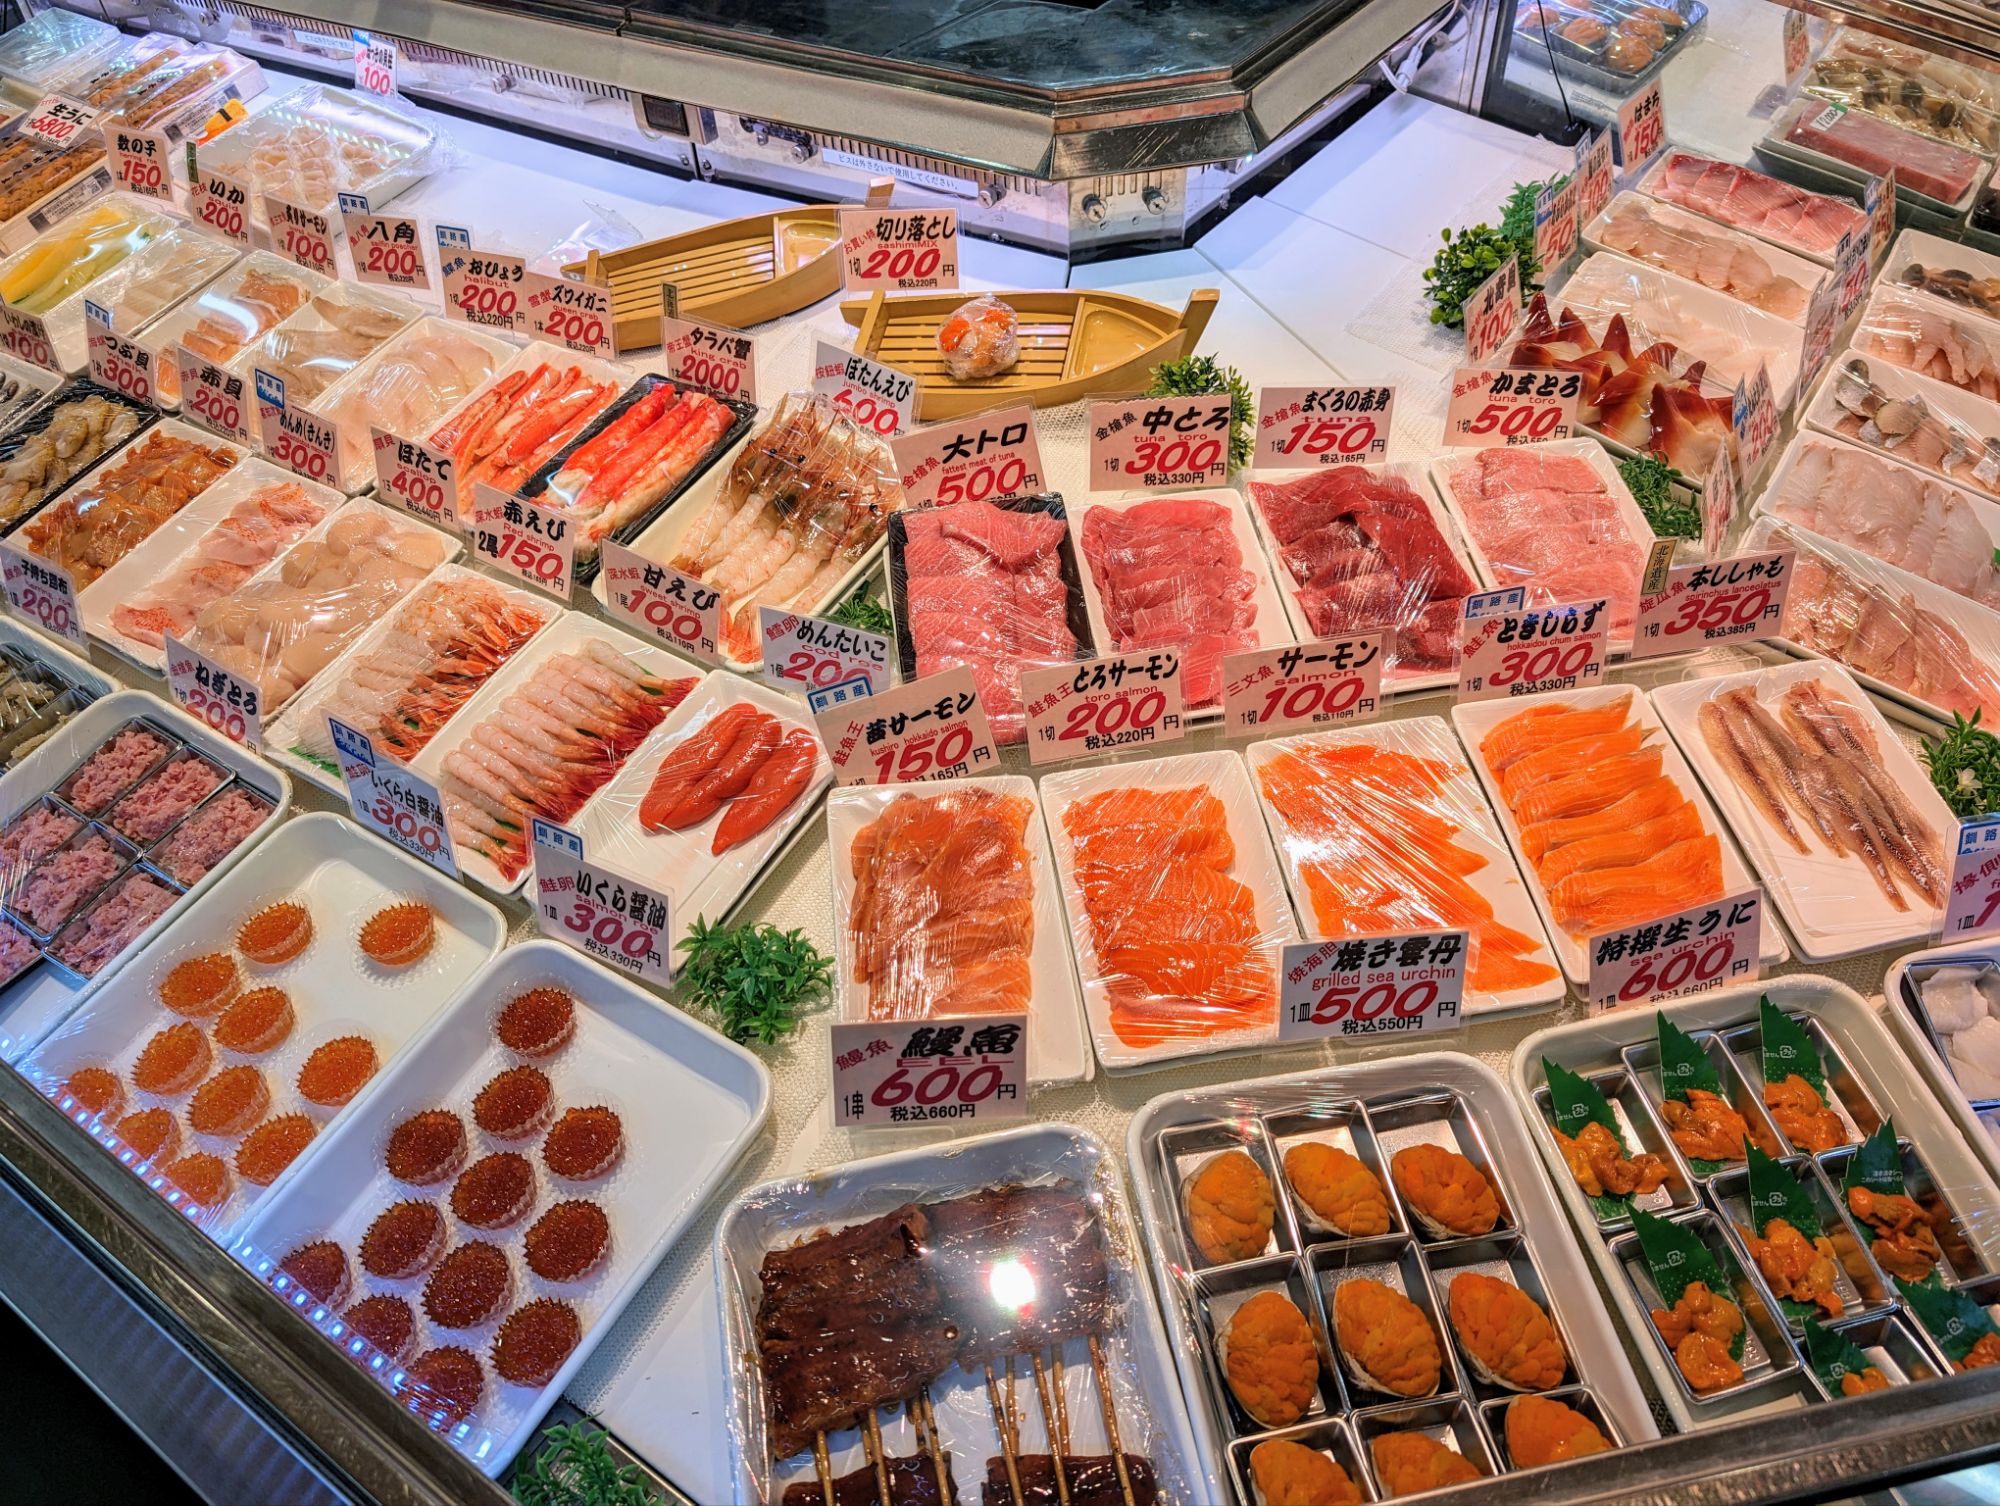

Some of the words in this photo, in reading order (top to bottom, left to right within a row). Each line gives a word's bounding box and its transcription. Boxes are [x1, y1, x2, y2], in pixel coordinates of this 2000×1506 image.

[364, 66, 390, 95] 100
[31, 115, 76, 139] 6800
[48, 103, 93, 126] 生うに
[117, 134, 156, 157] 数の子
[123, 160, 162, 187] 150
[208, 196, 239, 213] squid
[209, 178, 245, 205] いか
[202, 201, 243, 234] 200
[367, 221, 415, 244] 八角
[876, 215, 956, 242] 切り落とし
[286, 230, 328, 263] 100
[367, 246, 417, 275] 200
[878, 240, 938, 250] sashimiMIX
[468, 258, 523, 282] おひょう
[861, 248, 941, 279] 200
[464, 274, 510, 288] halibut
[898, 278, 938, 289] 税込220円
[459, 284, 518, 317] 200
[552, 284, 607, 313] ズワイガニ
[553, 304, 578, 316] queen
[466, 308, 514, 329] 税込220円
[544, 311, 604, 346] 200
[8, 329, 48, 365] 100
[104, 335, 149, 370] つぶ貝
[690, 326, 752, 361] タラバ蟹
[690, 346, 716, 362] king
[720, 356, 748, 370] crab
[103, 358, 149, 400] 300
[200, 365, 243, 401] 赤貝
[679, 354, 740, 394] 2000
[845, 357, 913, 403] ぼたんえび
[1489, 371, 1581, 399] かまとろ
[191, 389, 239, 429] 200
[842, 380, 867, 395] jumbo
[870, 392, 896, 408] shrimp
[1302, 387, 1391, 413] まぐろの赤身
[1488, 394, 1518, 403] tuna
[1529, 396, 1556, 405] toro
[1142, 405, 1230, 435] 中とろ
[1301, 415, 1372, 424] tuna
[1469, 403, 1563, 437] 500
[942, 422, 1028, 464] 大トロ
[1133, 435, 1166, 443] tuna
[1178, 433, 1208, 441] toro
[1282, 422, 1377, 455] 150
[274, 435, 326, 477] 300
[398, 440, 451, 481] ほたて
[942, 463, 967, 475] fattest
[969, 458, 988, 469] meat
[989, 456, 997, 464] of
[998, 452, 1016, 462] tuna
[1125, 439, 1222, 475] 300
[1319, 453, 1366, 464] 税込165円
[391, 470, 444, 511] 400
[935, 458, 1026, 507] 500
[1144, 472, 1205, 486] 税込330円
[503, 499, 567, 541] 赤えび
[504, 523, 523, 537] Red
[527, 534, 554, 552] shrimp
[497, 534, 564, 580] 150
[640, 585, 668, 602] sweet
[671, 601, 701, 619] shrimp
[643, 563, 721, 611] 甘えび
[1685, 588, 1729, 602] spirinchus
[1732, 581, 1782, 594] lanceolatus
[22, 588, 70, 630] 200
[627, 589, 703, 641] 100
[1497, 600, 1606, 644] ときしらず
[1664, 589, 1772, 636] 350
[656, 626, 695, 653] 税込110円
[796, 620, 886, 662] めんたいこ
[1550, 636, 1571, 646] chum
[1574, 631, 1601, 642] salmon
[1704, 622, 1756, 640] 税込385円
[802, 644, 840, 659] cod
[849, 656, 883, 672] roe
[1073, 654, 1178, 693] とろサーモン
[1278, 641, 1379, 677] サーモン
[1489, 641, 1593, 686] 300
[195, 661, 257, 716] ねぎとろ
[1085, 692, 1111, 703] toro
[1115, 685, 1158, 698] salmon
[1227, 665, 1275, 697] 三文魚
[1274, 669, 1356, 686] salmon
[1510, 676, 1576, 697] 税込330円
[815, 684, 866, 708] 釧路産
[1259, 677, 1365, 722] 100
[186, 689, 246, 741] 200
[866, 692, 976, 745] 茜サーモン
[1059, 691, 1166, 741] 200
[1312, 709, 1354, 723] 税込110円
[870, 742, 899, 757] kushiro
[903, 729, 938, 745] hokkaido
[940, 720, 968, 735] salmon
[1085, 726, 1155, 751] 税込220円
[875, 727, 973, 784] 150
[371, 798, 442, 852] 300
[538, 826, 579, 853] 釧路産
[389, 827, 435, 862] 税込330円
[576, 870, 667, 930] いくら醤油
[576, 894, 628, 922] salmon
[633, 920, 660, 935] roe
[564, 903, 655, 959] 300
[1596, 900, 1757, 966] 特撰生うに
[584, 937, 644, 975] 税込330円
[1331, 934, 1462, 973] 焼き雲丹
[1630, 953, 1664, 967] sea
[1672, 931, 1735, 955] urchin
[1311, 970, 1361, 991] grilled
[1366, 971, 1394, 984] sea
[1401, 964, 1456, 980] urchin
[1618, 939, 1735, 1002] 600
[1310, 980, 1439, 1025] 500
[1341, 1015, 1423, 1035] 税込550円
[896, 1055, 1015, 1068] EEL
[871, 1065, 1003, 1107] 600
[890, 1103, 976, 1122] 税込660円
